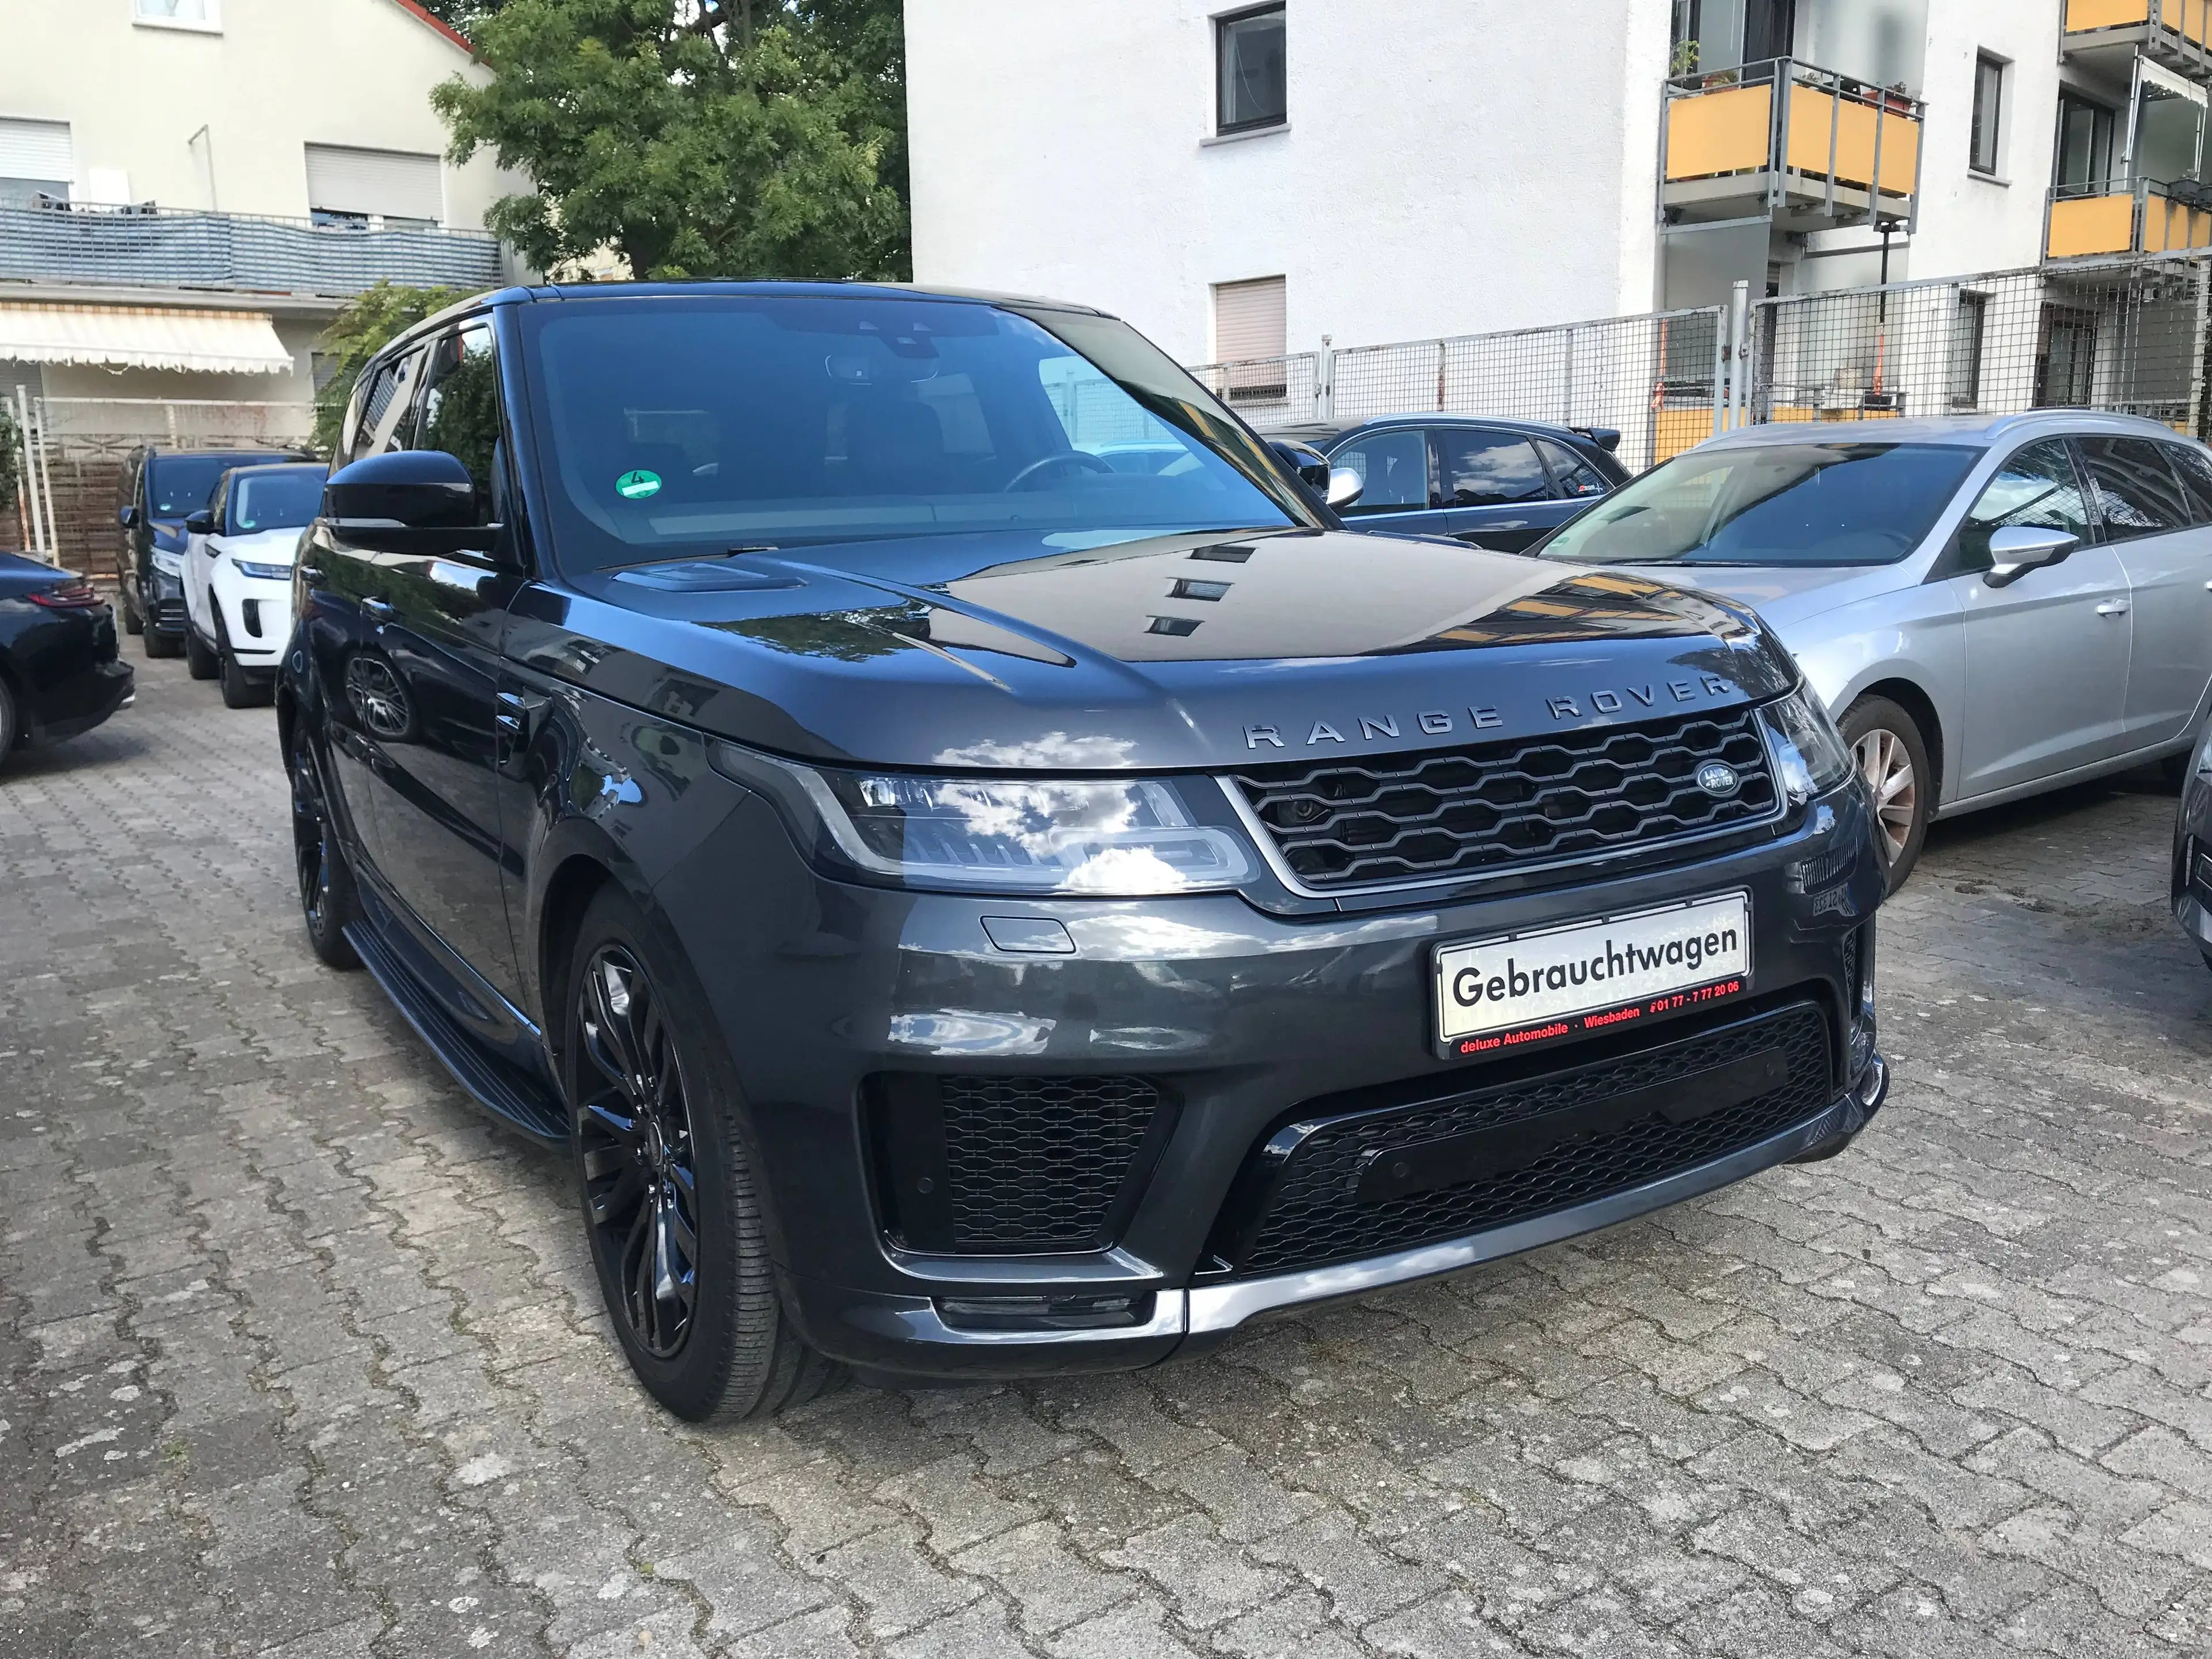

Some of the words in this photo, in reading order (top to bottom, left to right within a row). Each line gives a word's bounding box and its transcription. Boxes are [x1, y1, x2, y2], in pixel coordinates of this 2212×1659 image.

[631, 471, 645, 484] 4
[1243, 704, 1503, 749] RANGE
[1546, 673, 1729, 719] ROVER
[1705, 768, 1725, 780] LAND
[1710, 775, 1734, 788] ROVER
[1452, 928, 1737, 1007] Gebrauchtwagen
[1460, 1037, 1501, 1054] deluxe
[1503, 1022, 1569, 1046] Automobile
[1584, 1007, 1640, 1028] Wiesbaden
[1657, 998, 1669, 1012] 01
[1672, 995, 1684, 1008] 77
[1692, 991, 1699, 1003] 7
[1701, 987, 1713, 1001] 77
[1714, 984, 1726, 997] 20
[1728, 981, 1740, 993] 06
